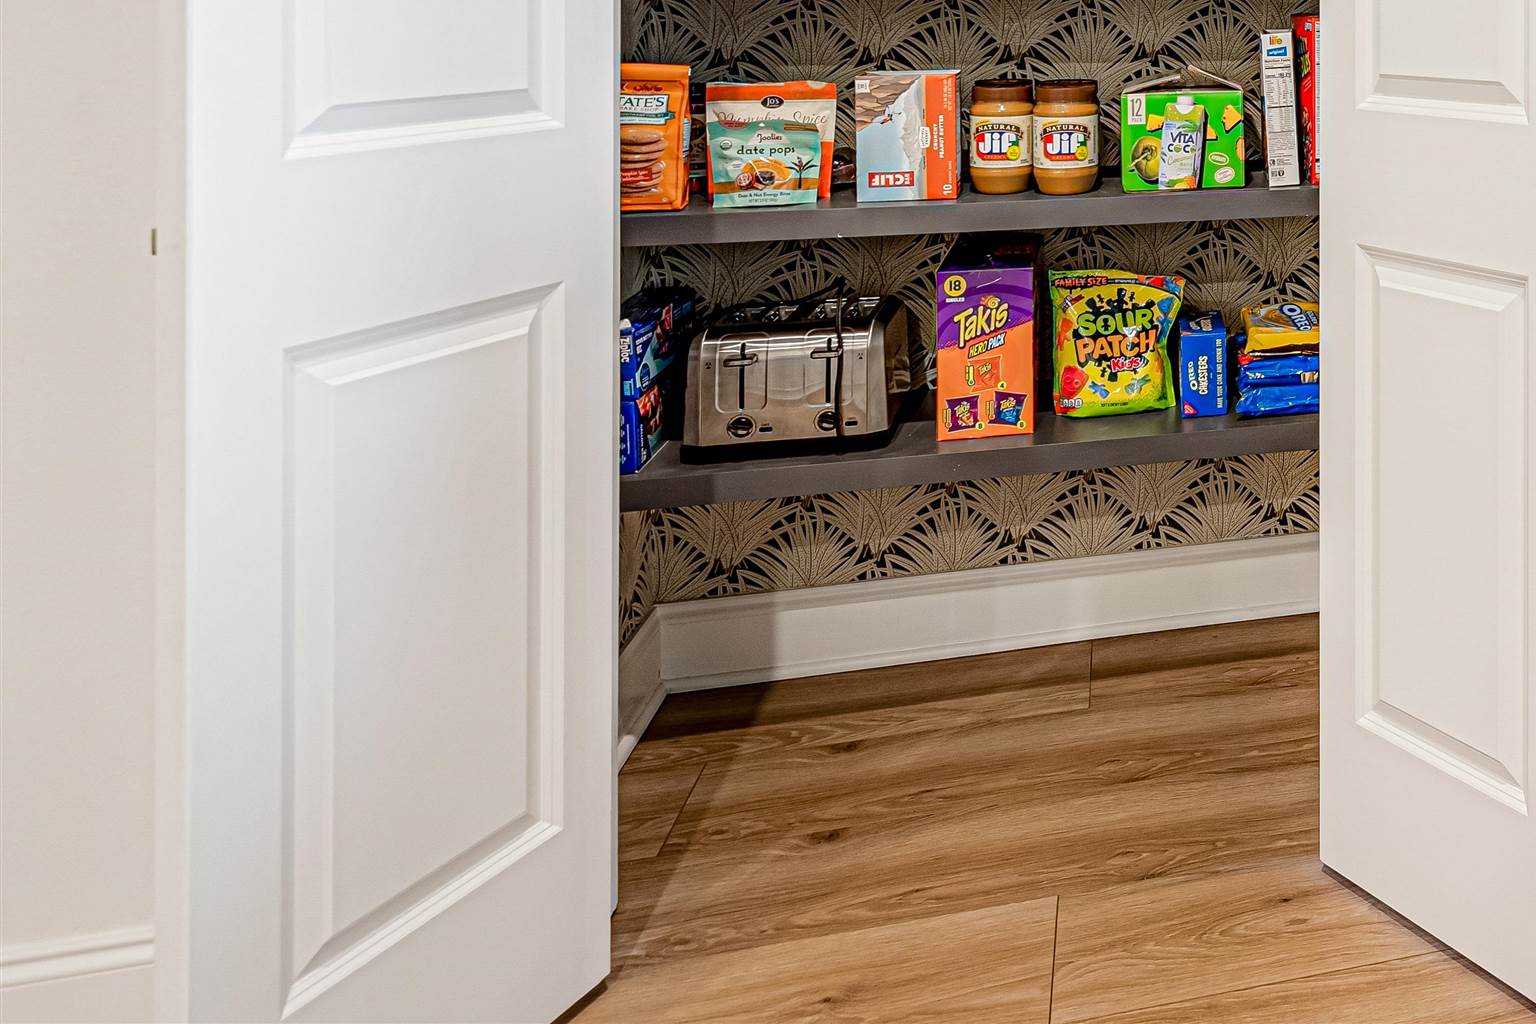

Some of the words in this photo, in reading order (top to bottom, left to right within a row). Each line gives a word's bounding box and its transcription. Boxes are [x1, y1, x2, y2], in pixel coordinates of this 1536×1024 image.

[1130, 98, 1142, 117] 12
[756, 133, 782, 144] Joolies
[978, 133, 1017, 154] Jif
[1046, 133, 1085, 155] Jif
[1168, 143, 1197, 153] COCO
[1170, 132, 1194, 144] VITA
[736, 145, 765, 155] date
[769, 146, 795, 156] pops
[943, 184, 952, 195] 10
[949, 280, 962, 291] 18
[1054, 277, 1086, 287] FAMILY
[1087, 277, 1107, 286] SIZE
[953, 297, 1009, 348] Takis
[1078, 309, 1153, 336] SOUR
[1282, 304, 1311, 331] OREO
[620, 337, 630, 363] Ziploc
[969, 341, 987, 357] HERO
[988, 333, 1005, 350] PACK
[1076, 329, 1157, 364] PATCH
[1111, 357, 1142, 372] Kids
[1188, 361, 1198, 391] OREO
[1198, 356, 1208, 395] CAKESTERS
